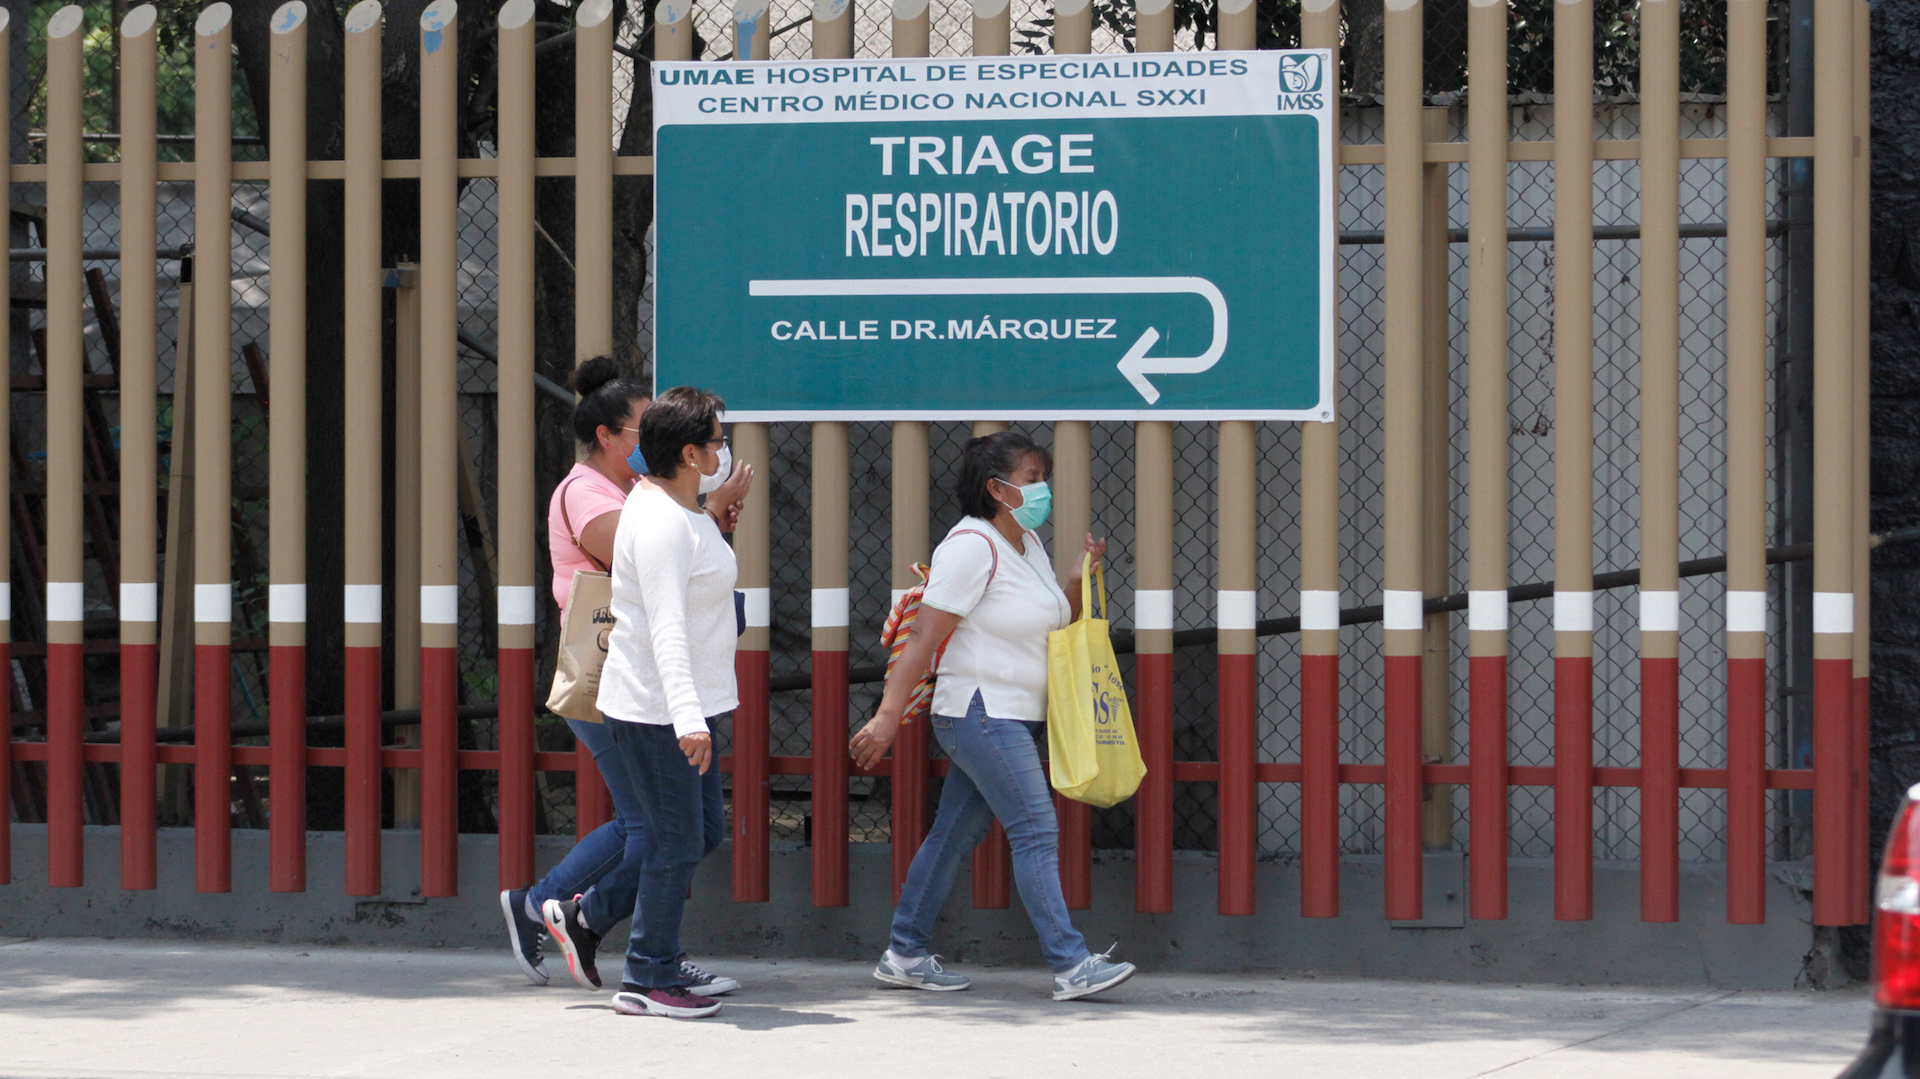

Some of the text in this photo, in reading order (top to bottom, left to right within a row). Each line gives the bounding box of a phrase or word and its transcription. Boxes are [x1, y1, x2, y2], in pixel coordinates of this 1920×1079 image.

[660, 59, 1247, 85] UMAE HOSPITAL DE ESPECIALIDADES
[698, 89, 1205, 113] CENTRO MÉDICO NACIONAL SXXI
[1278, 92, 1323, 110] IMSS
[870, 134, 1094, 175] TRIAGE
[846, 190, 1118, 257] RESPIRATORIO
[771, 315, 1116, 340] CALLE DR.MÁRQUEZ
[593, 606, 616, 624] FRU
